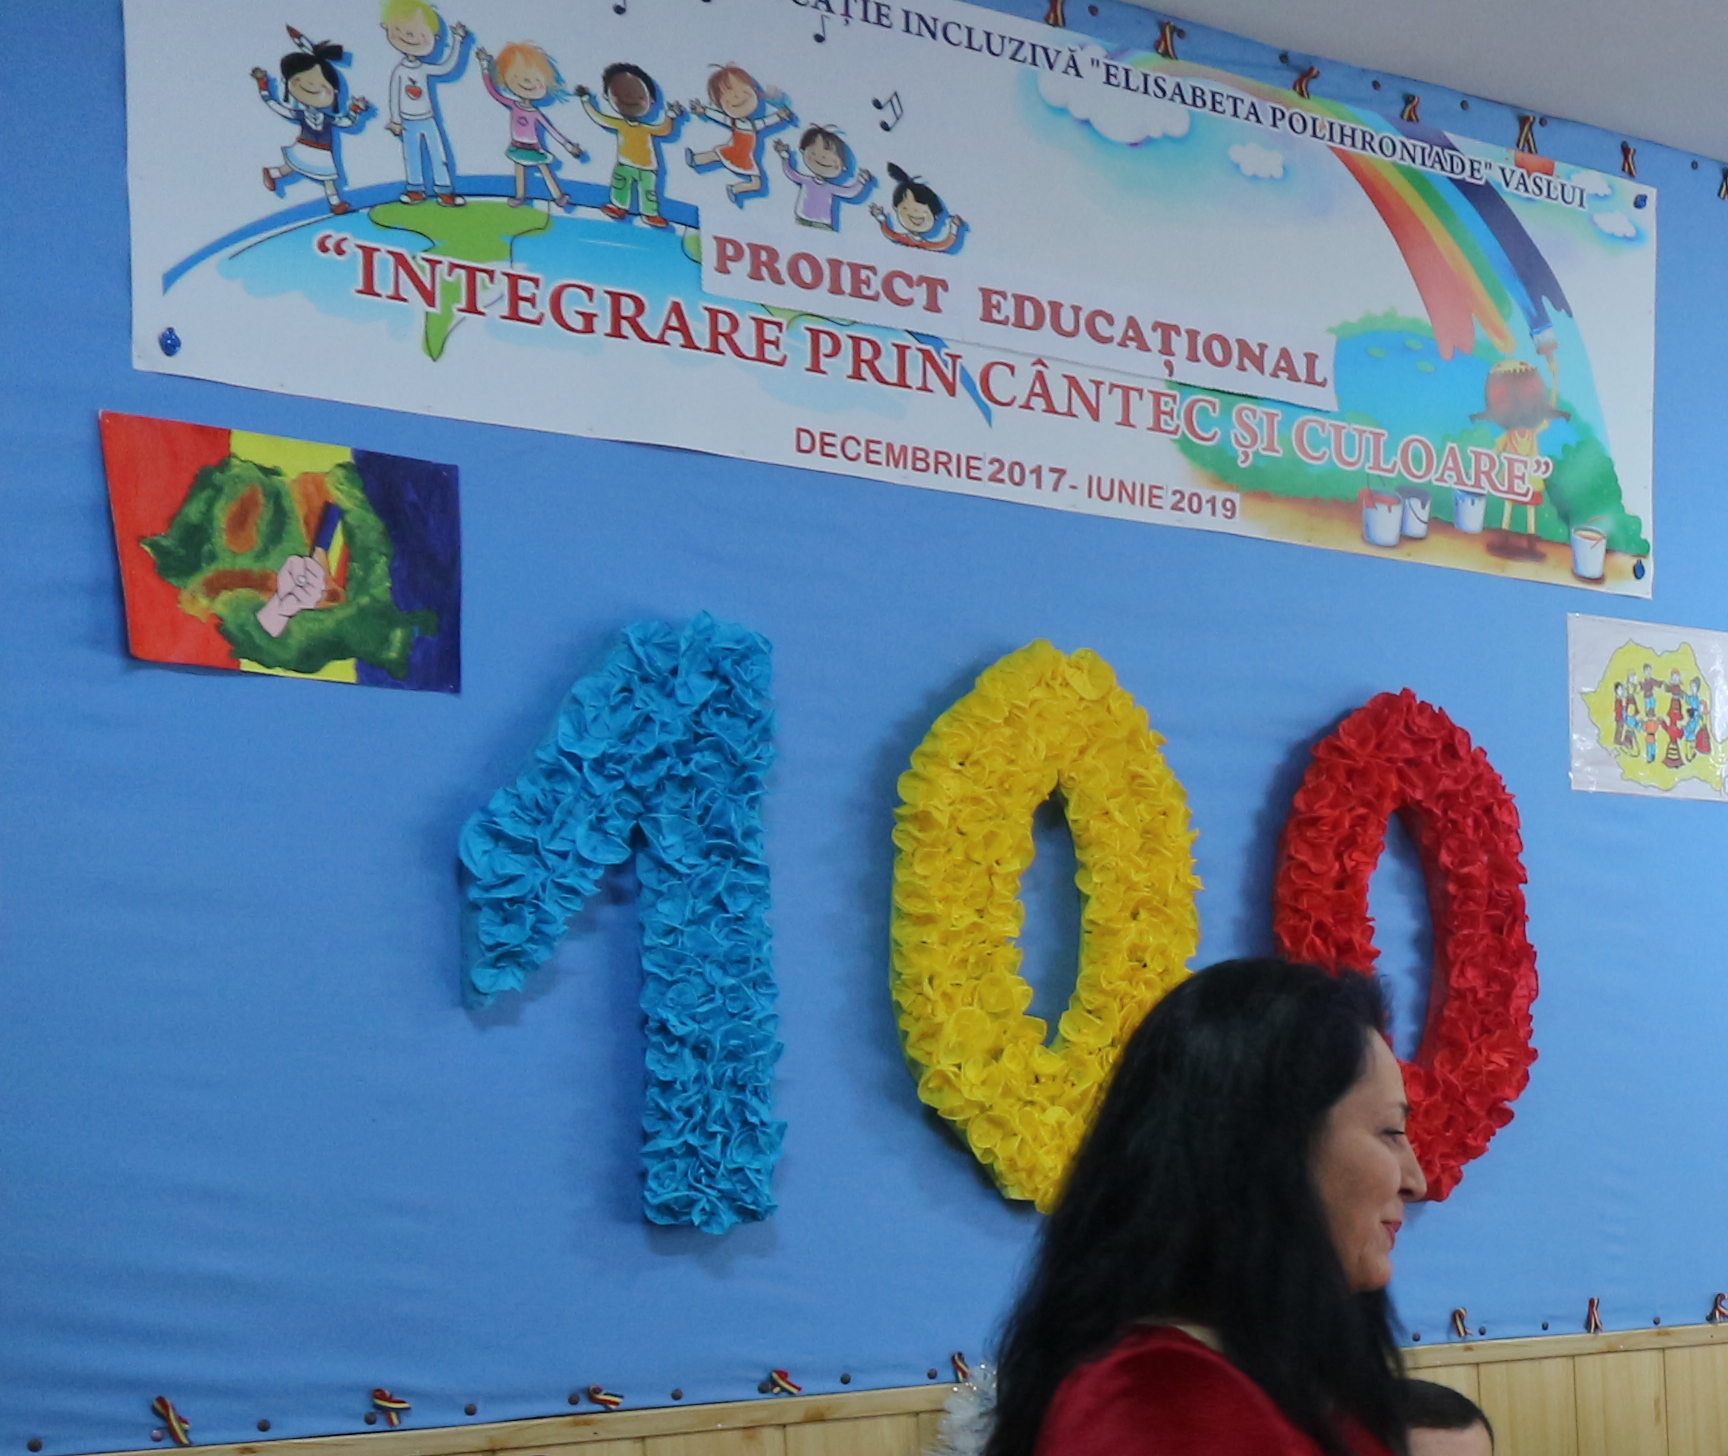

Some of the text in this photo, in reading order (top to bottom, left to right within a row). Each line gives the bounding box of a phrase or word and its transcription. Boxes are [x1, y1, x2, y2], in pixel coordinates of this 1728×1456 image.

[792, 0, 1587, 209] AȚIE INCLUZIVĂ "ELISABETA POLIHRONIADE" VASLUI
[714, 235, 1328, 389] PROIECT EDUCAȚIONAL
[805, 325, 962, 398] PRIN
[979, 356, 1222, 448] CÂNTEC
[1232, 405, 1282, 469] ȘI
[795, 427, 983, 483] DECEMBRIE
[1087, 475, 1164, 511] IUNIE
[1171, 489, 1238, 521] 2019
